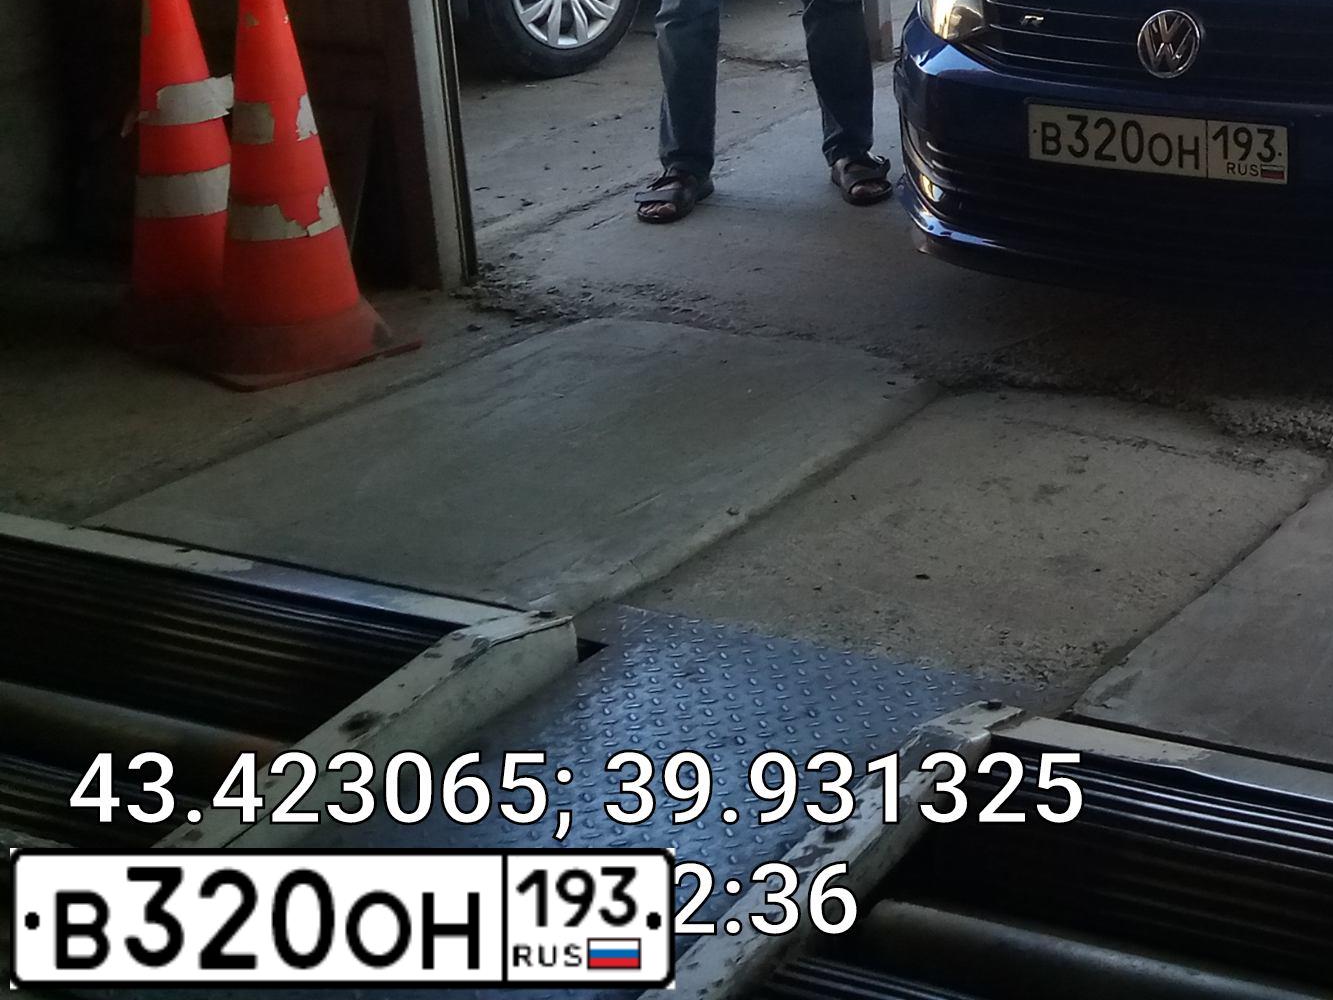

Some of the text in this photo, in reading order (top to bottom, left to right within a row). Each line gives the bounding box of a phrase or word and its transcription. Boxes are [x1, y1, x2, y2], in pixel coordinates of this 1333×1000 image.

[1040, 113, 1277, 170] В320ОН 193
[1226, 162, 1260, 177] RUS
